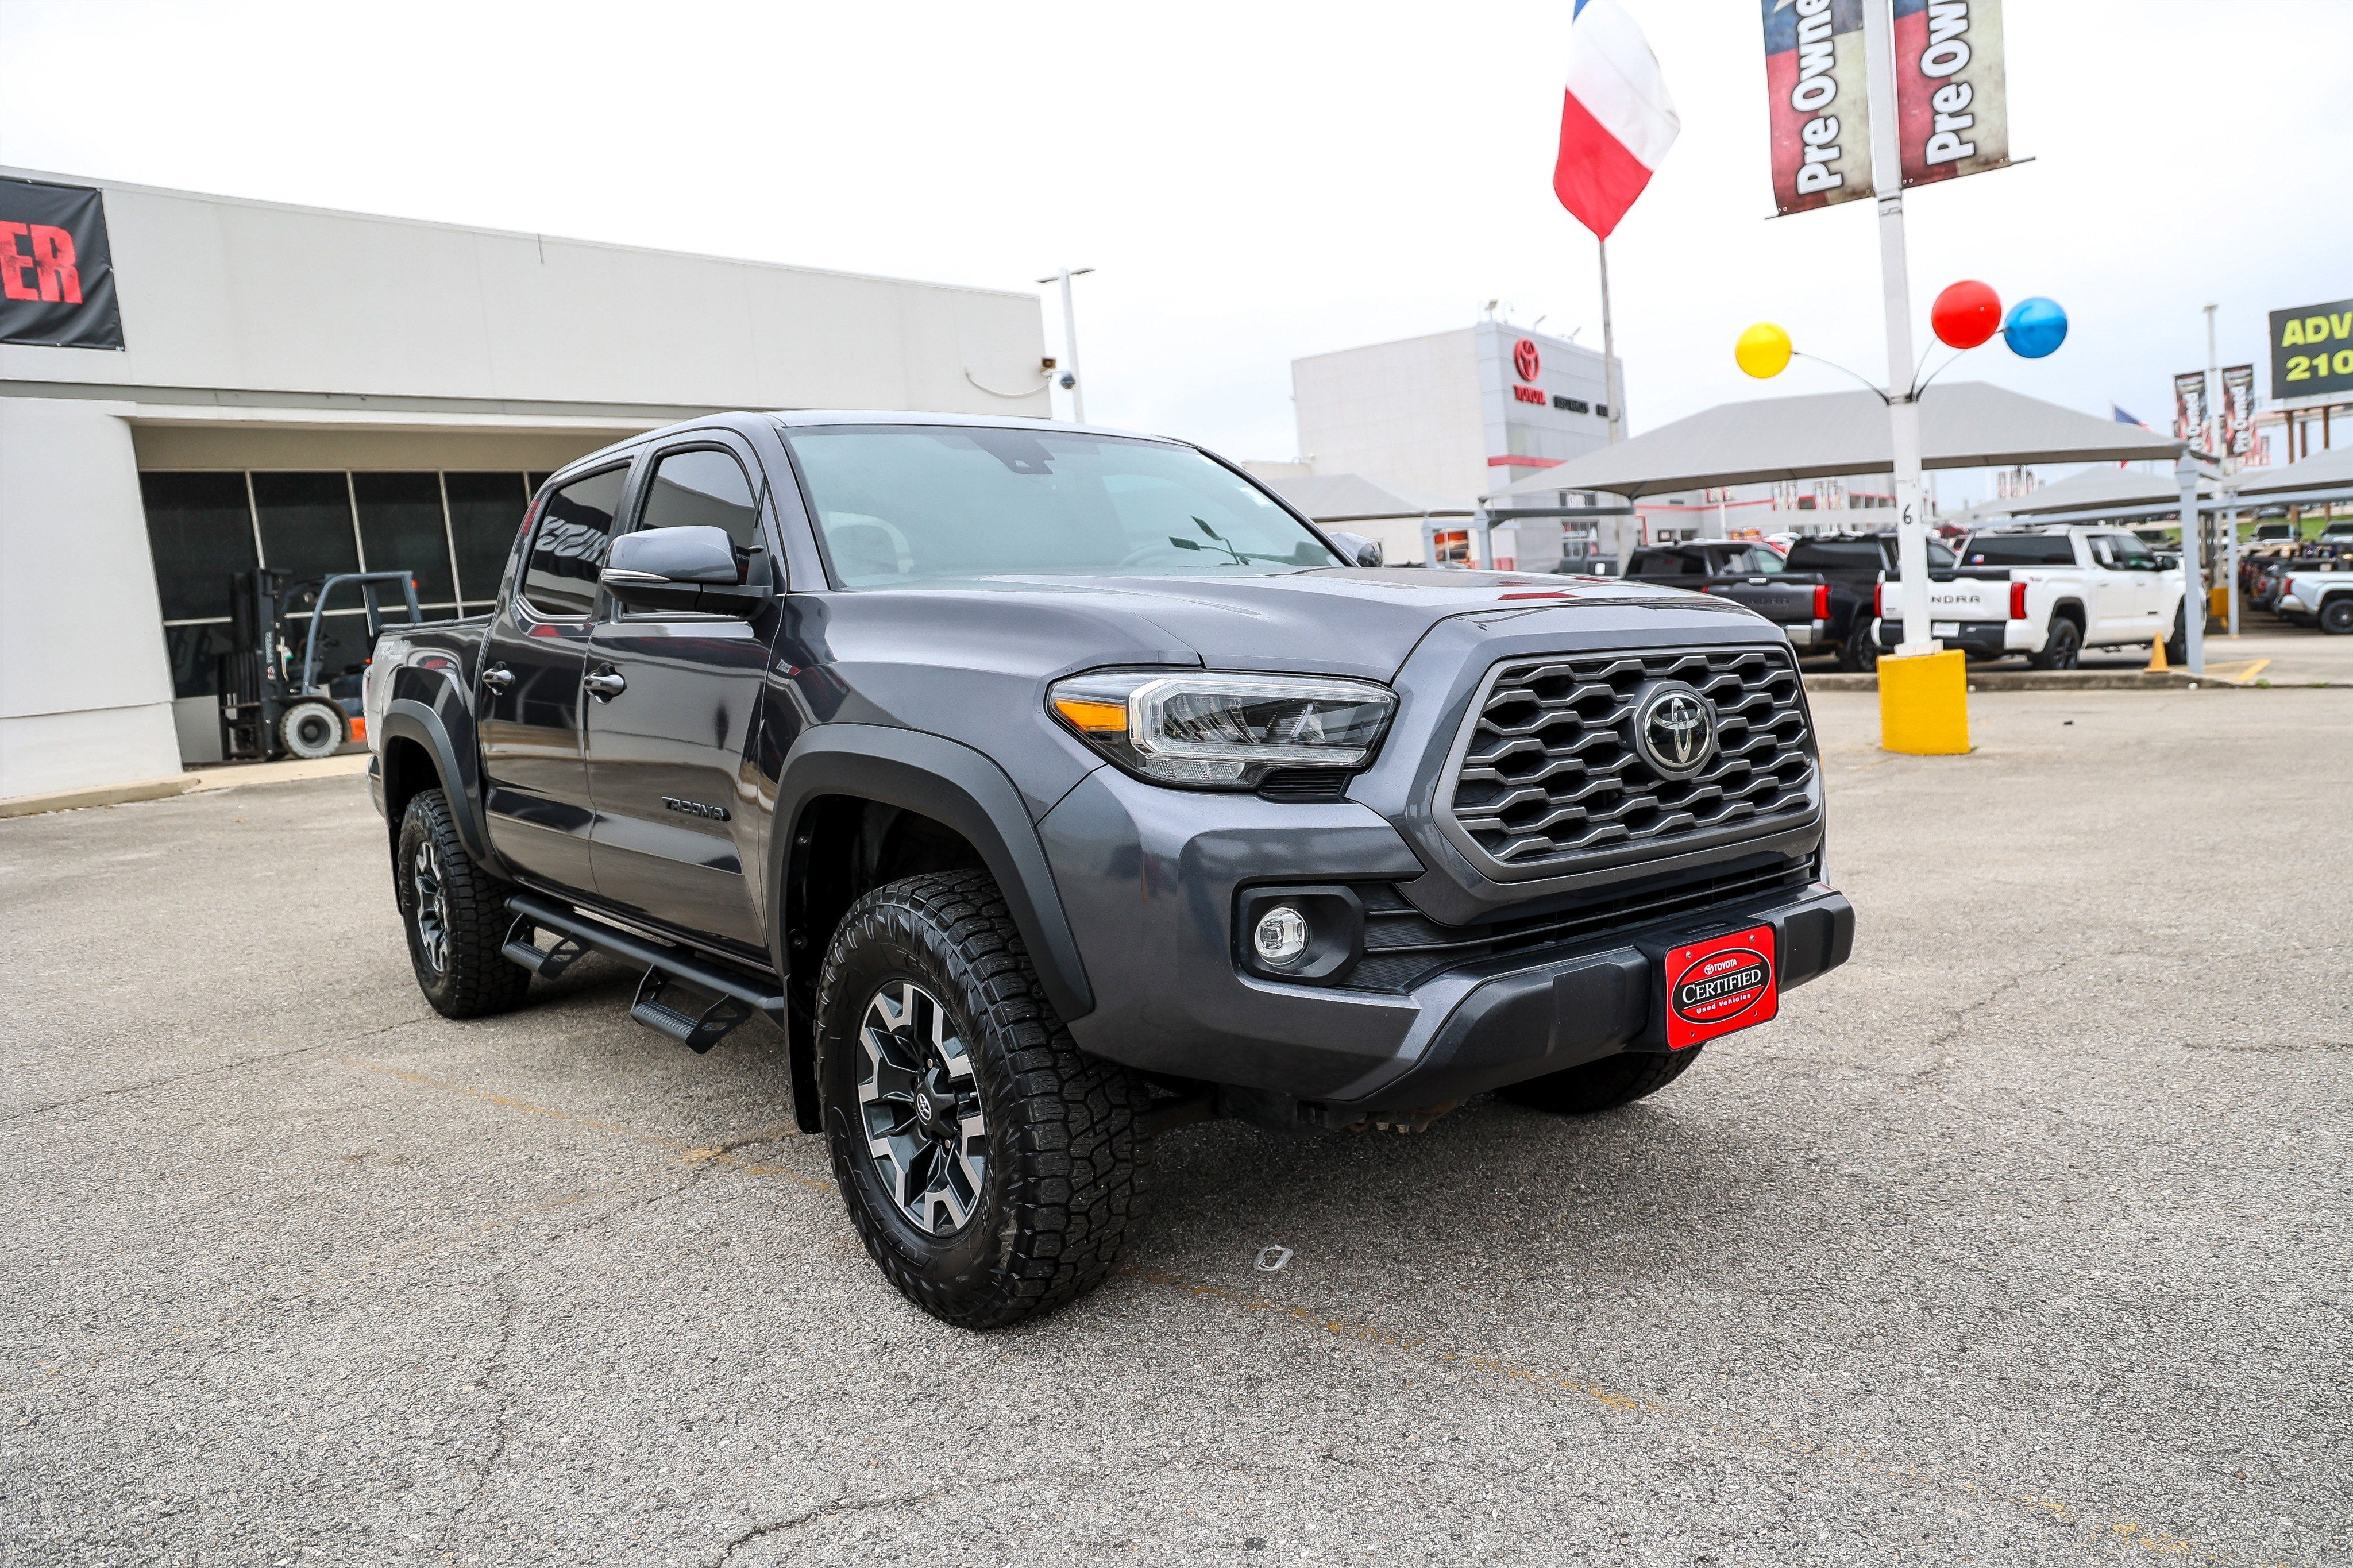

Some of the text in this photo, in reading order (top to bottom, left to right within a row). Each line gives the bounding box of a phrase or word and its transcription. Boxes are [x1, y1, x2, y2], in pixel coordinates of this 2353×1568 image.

[1920, 0, 1974, 165] Pre Ow
[1796, 115, 1842, 195] Pre
[2281, 311, 2353, 348] ADV
[2285, 349, 2353, 381] 210
[1903, 503, 1912, 524] 6
[1931, 595, 1981, 603] NDRA
[661, 795, 732, 822] TACOMA
[1714, 959, 1738, 971] TOYOTA
[1683, 969, 1761, 1003] CERTIFIED
[1696, 993, 1751, 1014] Used Vehicles
